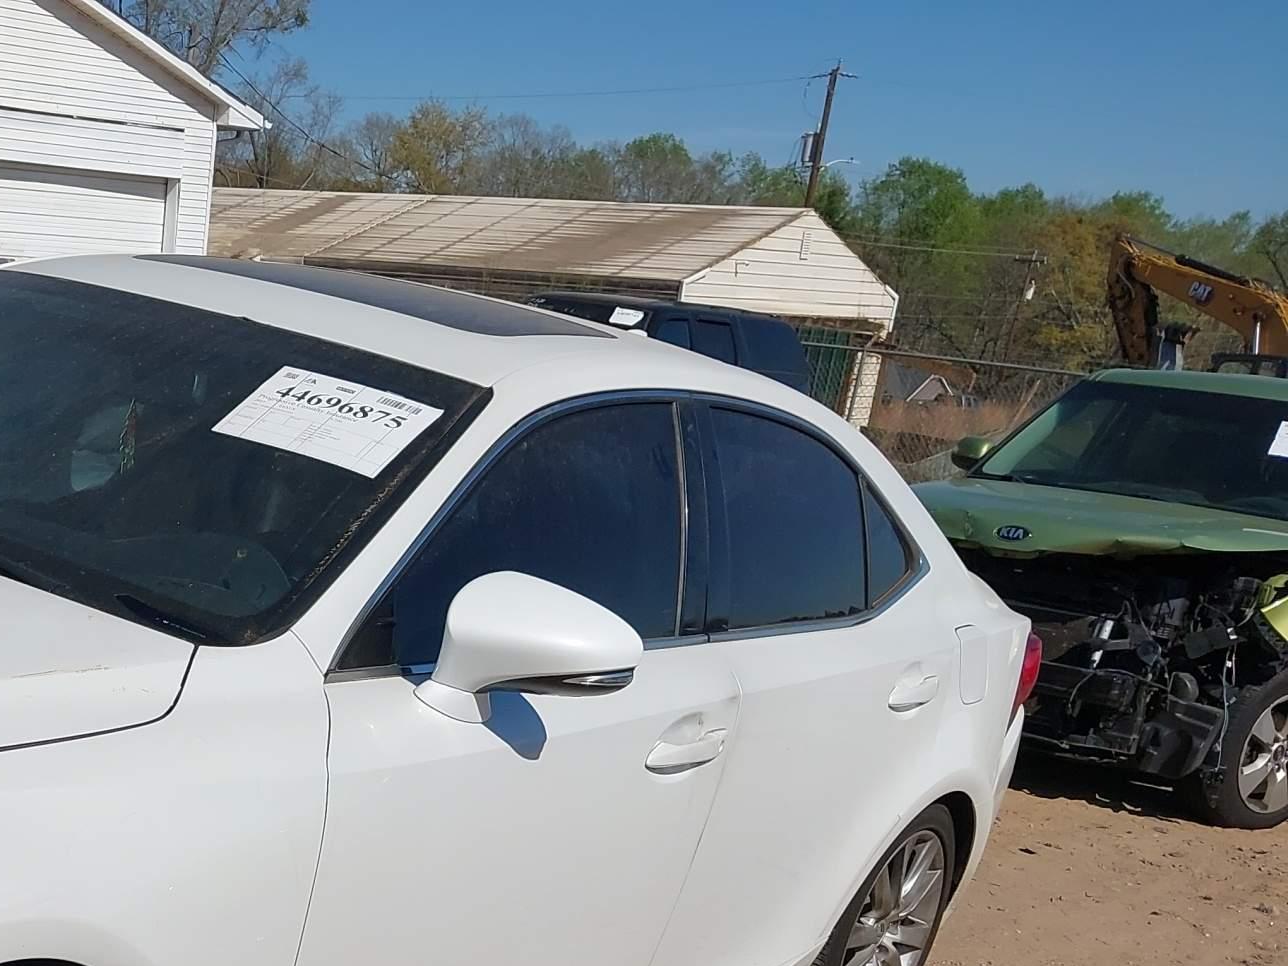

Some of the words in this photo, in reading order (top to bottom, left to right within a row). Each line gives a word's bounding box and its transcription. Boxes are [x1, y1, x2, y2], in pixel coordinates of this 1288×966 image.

[1188, 280, 1213, 301] CAT
[276, 386, 409, 429] 44696875
[999, 527, 1024, 540] KIA
